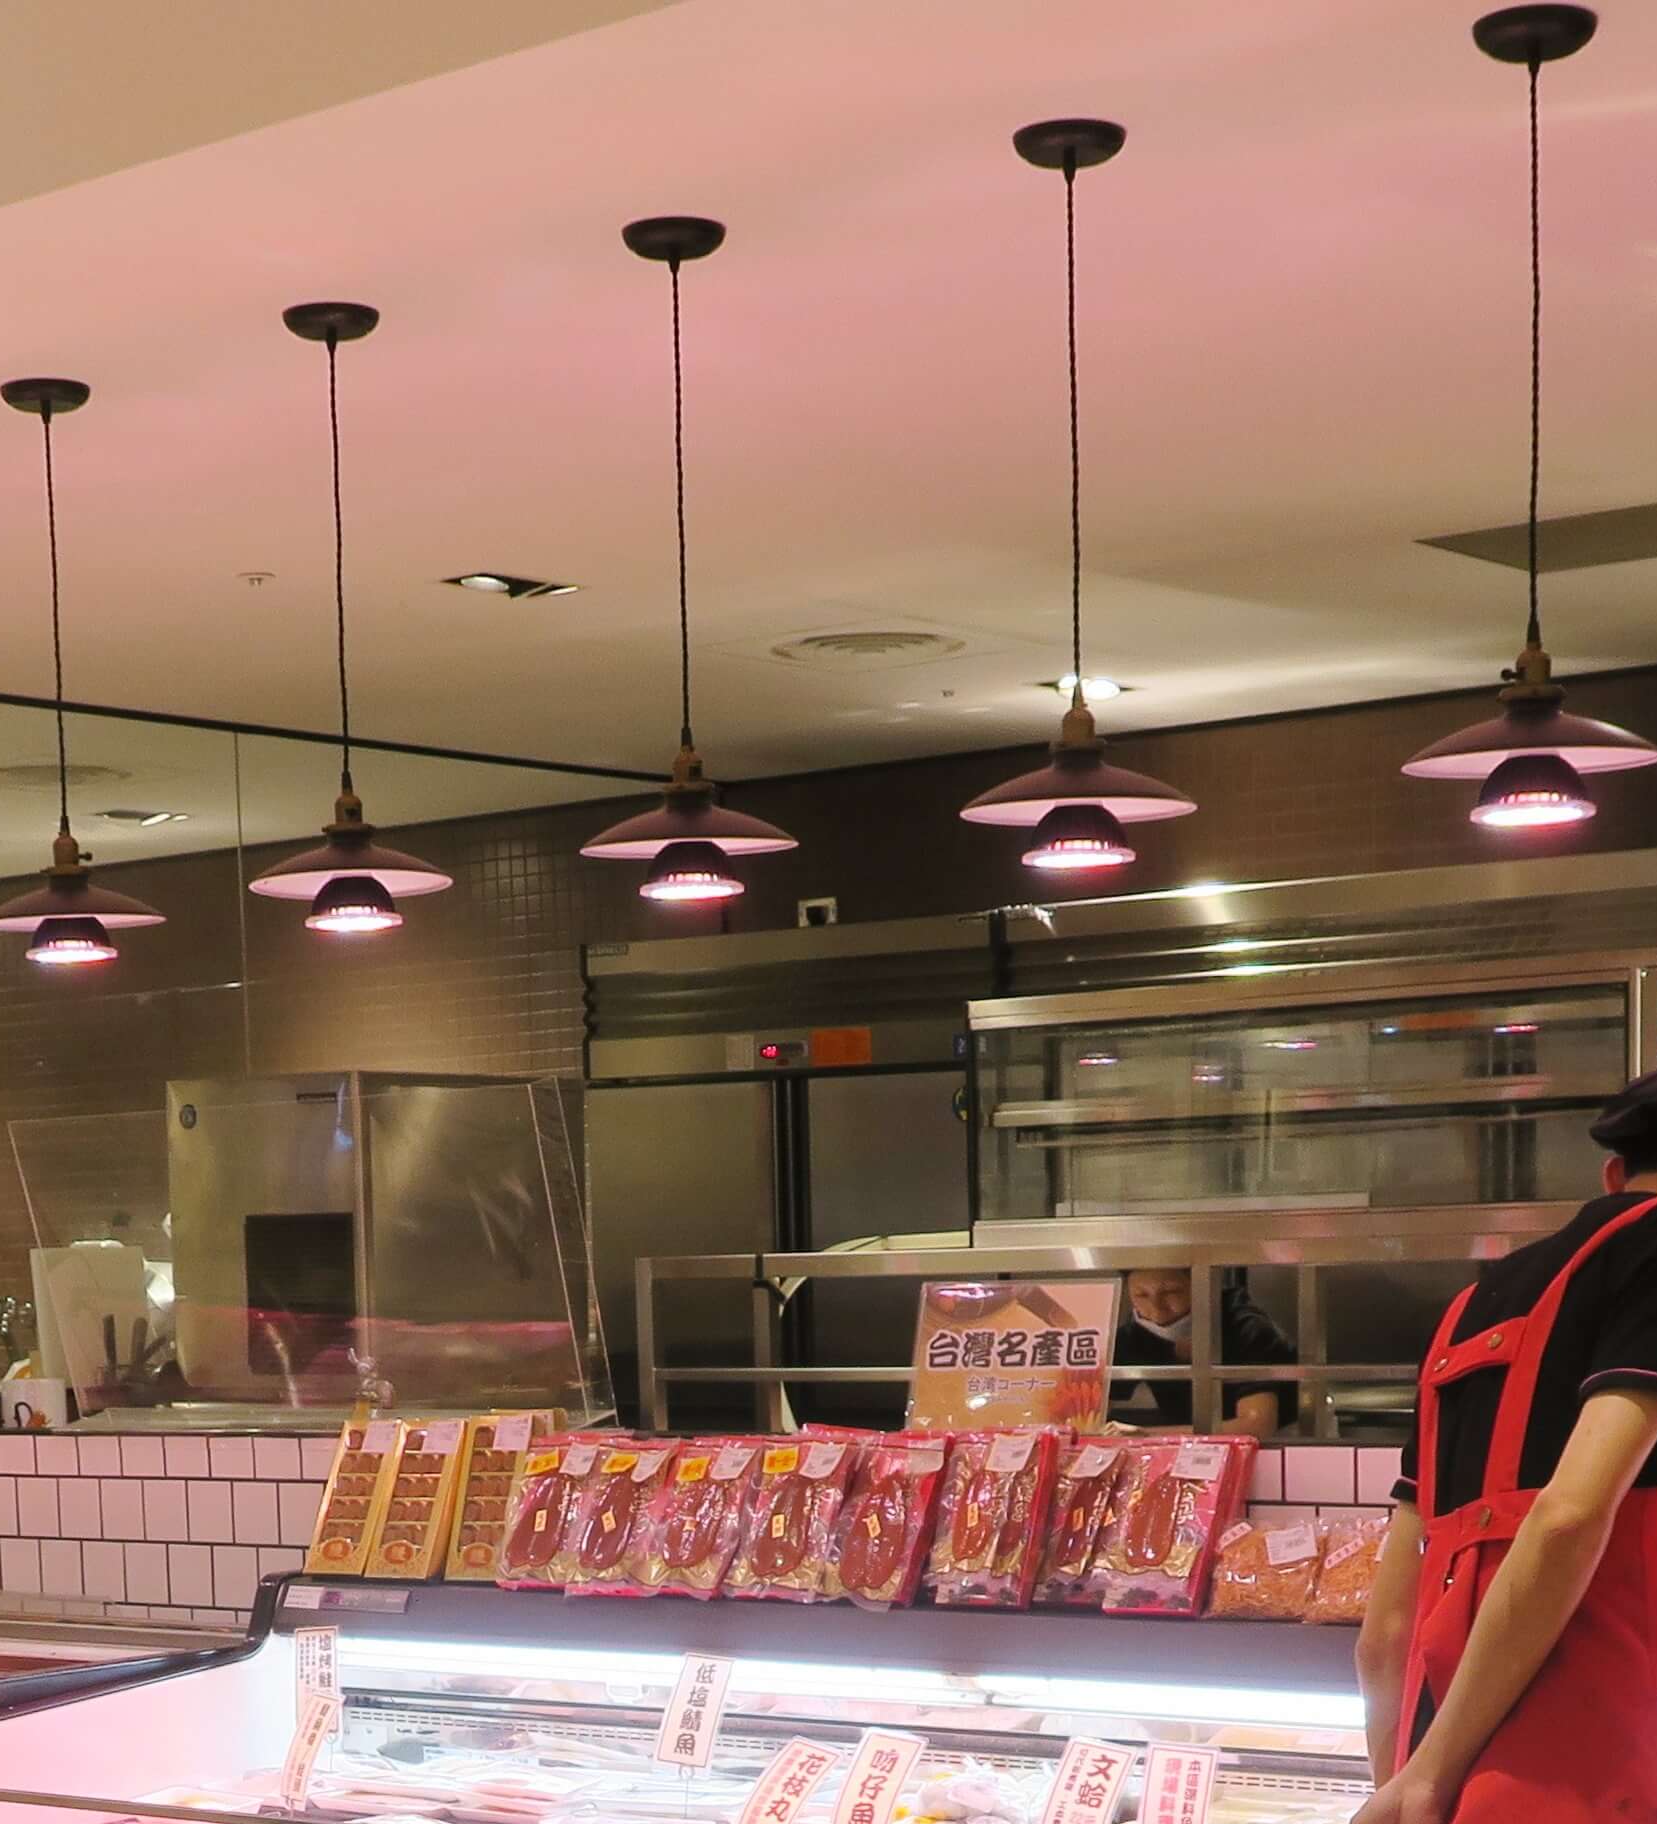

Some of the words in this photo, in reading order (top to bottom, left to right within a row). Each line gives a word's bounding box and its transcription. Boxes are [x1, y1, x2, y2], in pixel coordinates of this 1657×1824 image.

[928, 1329, 1100, 1369] 台灣名產區
[764, 1751, 828, 1823] 花枝丸
[1074, 1753, 1119, 1809] 文蛤
